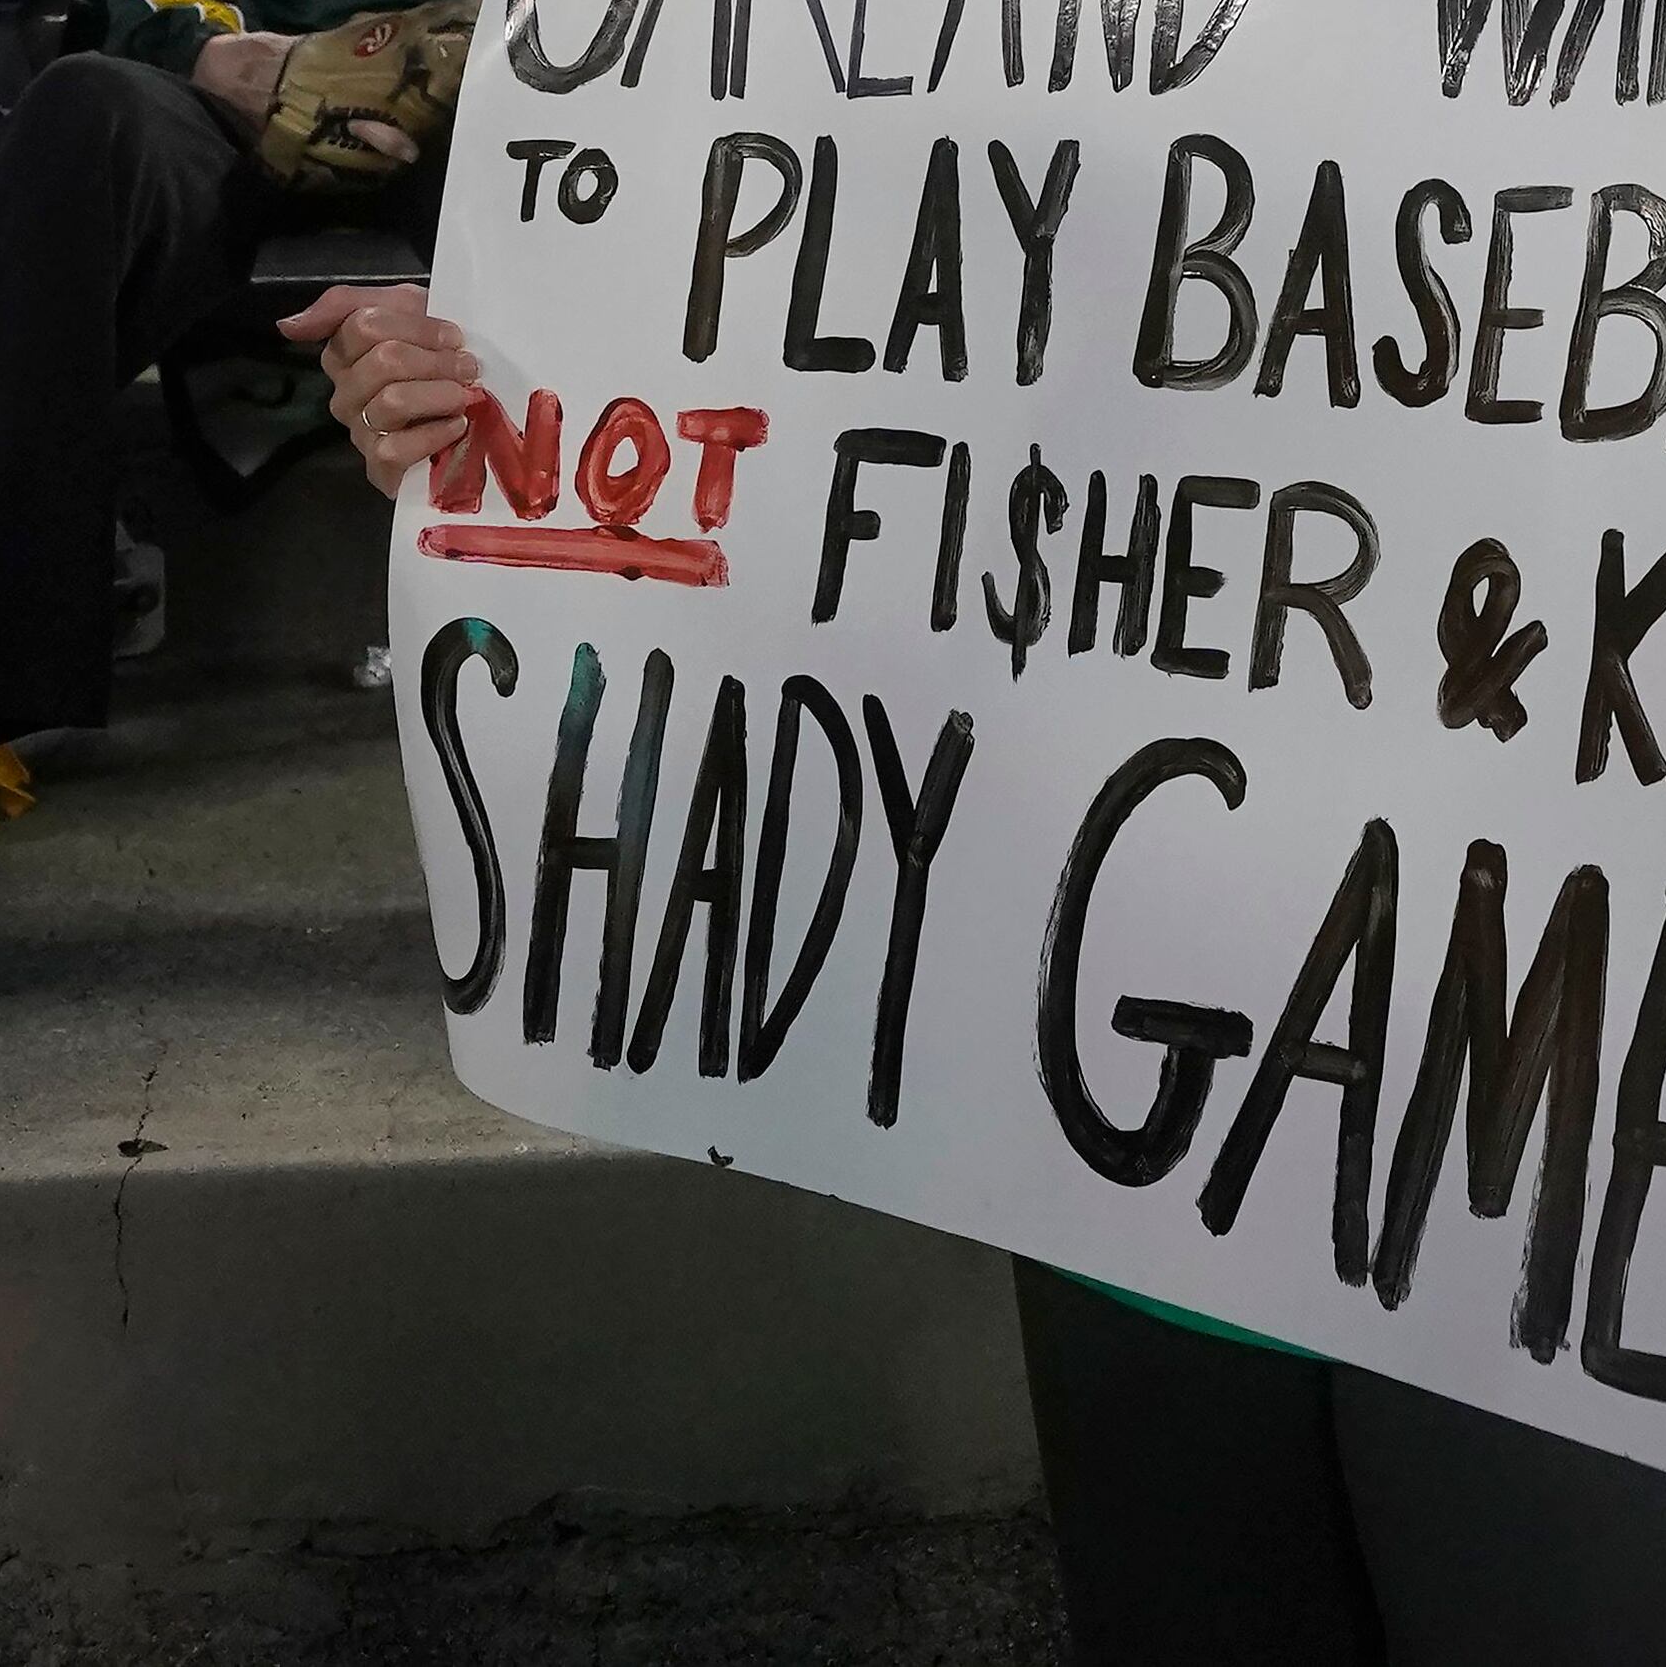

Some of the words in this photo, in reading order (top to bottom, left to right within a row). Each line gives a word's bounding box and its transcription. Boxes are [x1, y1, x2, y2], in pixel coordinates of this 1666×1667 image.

[506, 140, 618, 224] TO
[683, 132, 1081, 386] PLAY
[428, 386, 770, 532] NOT
[811, 428, 1379, 710] FI$HER
[1437, 538, 1548, 743] &
[419, 617, 975, 1130] SHADY
